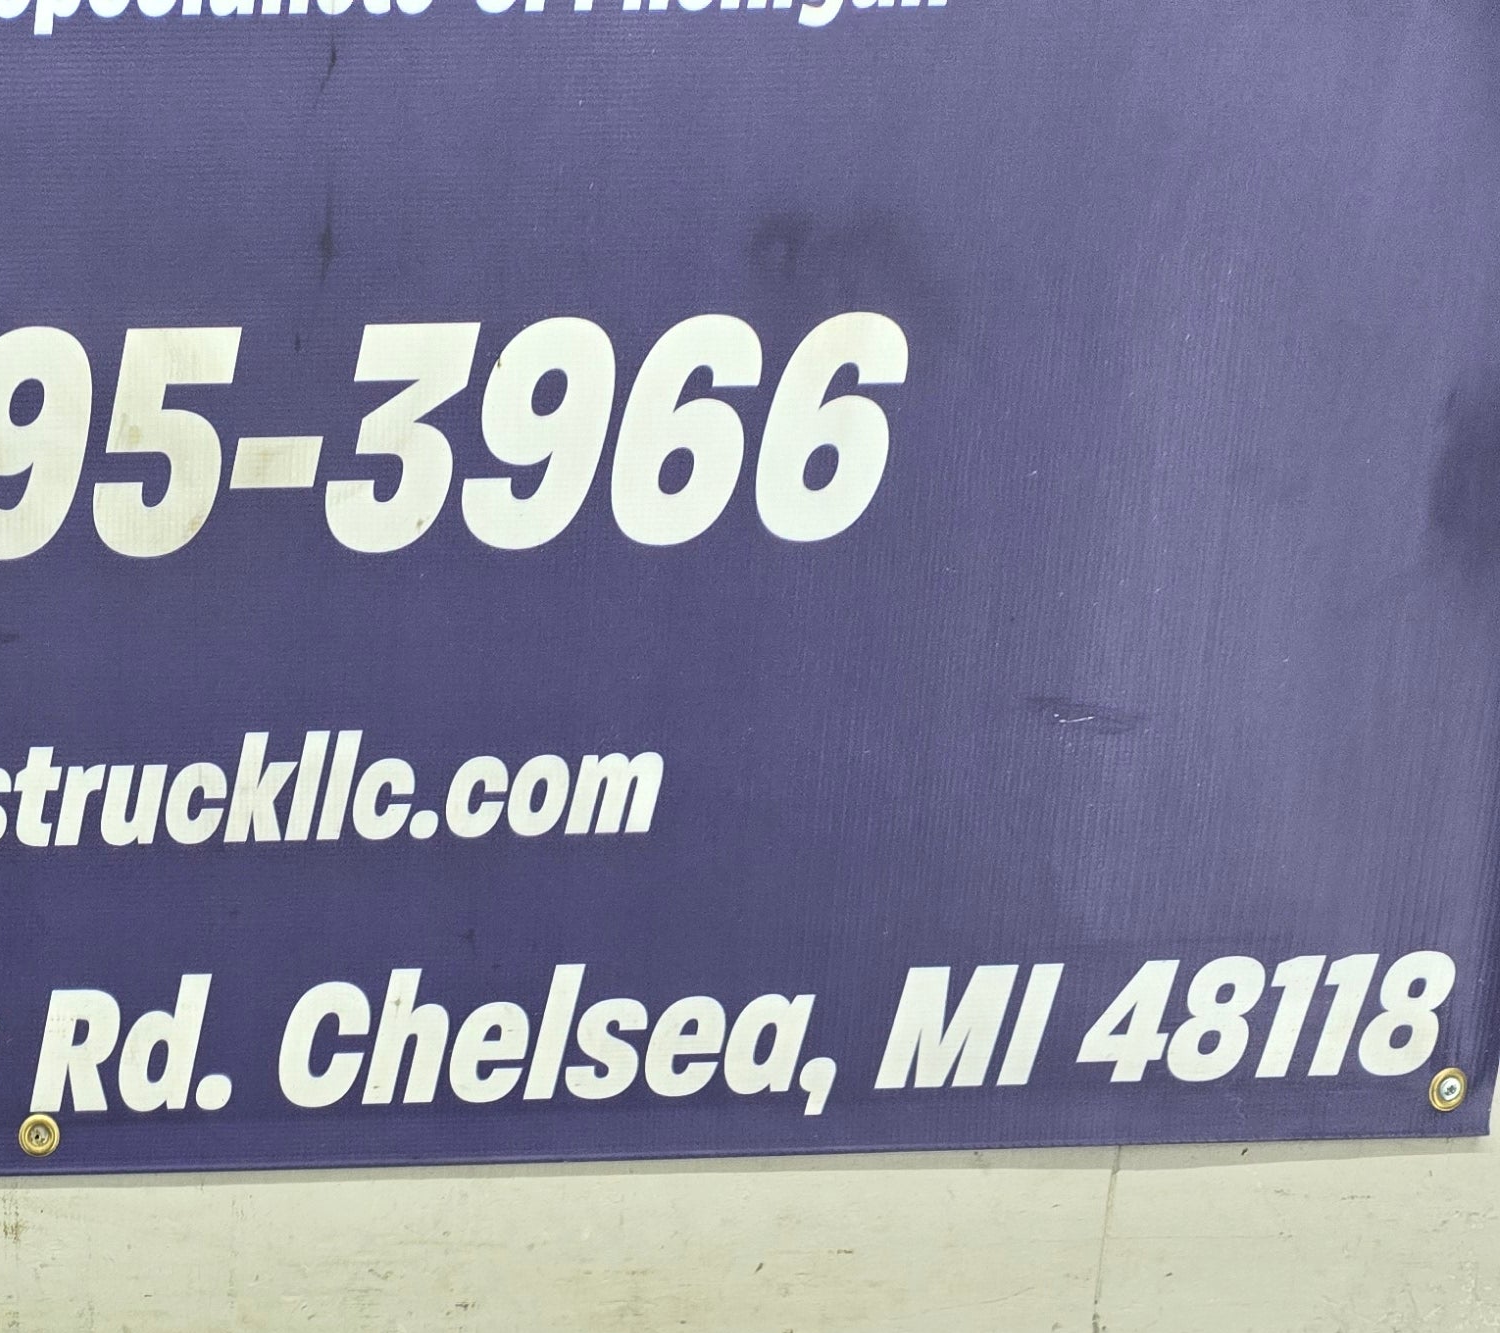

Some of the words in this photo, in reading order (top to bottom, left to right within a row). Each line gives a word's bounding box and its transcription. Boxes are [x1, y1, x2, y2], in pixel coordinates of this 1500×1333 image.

[29, 973, 233, 1113] Rd.
[278, 963, 837, 1116] Chelsea,
[873, 962, 1065, 1090] MI
[1075, 950, 1457, 1083] 48118
